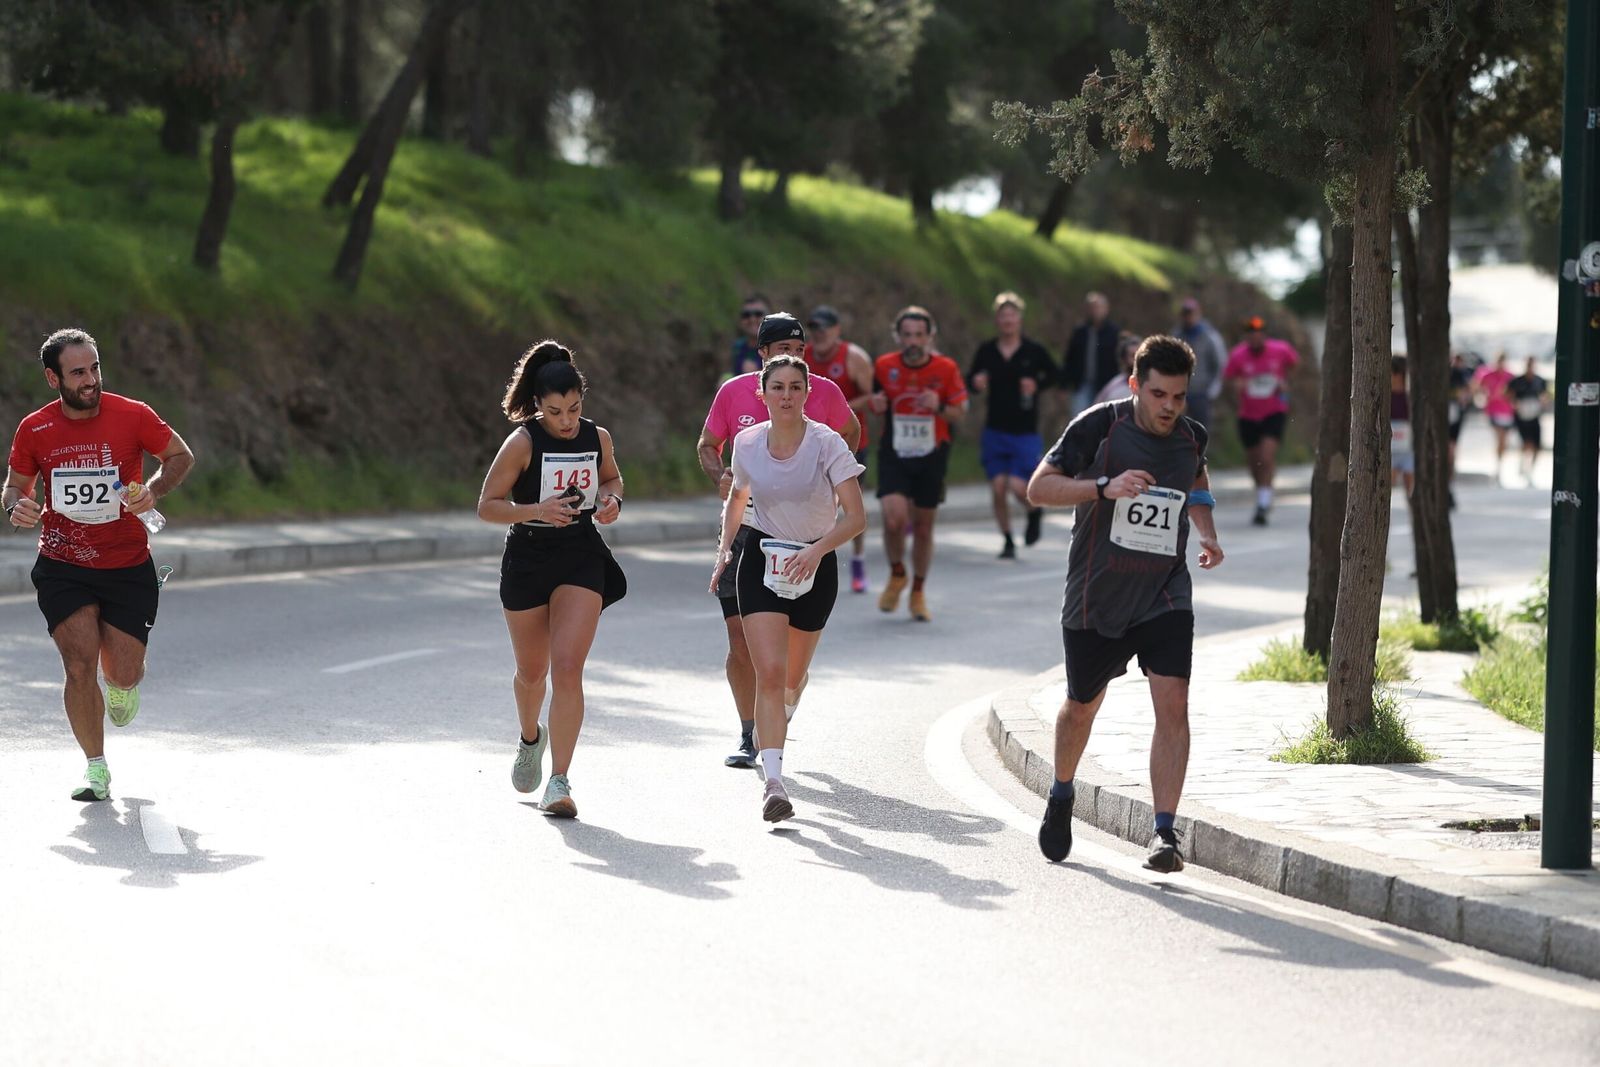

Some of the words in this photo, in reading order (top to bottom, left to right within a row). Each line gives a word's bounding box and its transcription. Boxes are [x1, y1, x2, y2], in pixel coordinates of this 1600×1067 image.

[60, 444, 97, 454] GENERALI
[553, 469, 590, 490] 143
[64, 483, 109, 505] 592
[1127, 502, 1170, 530] 621
